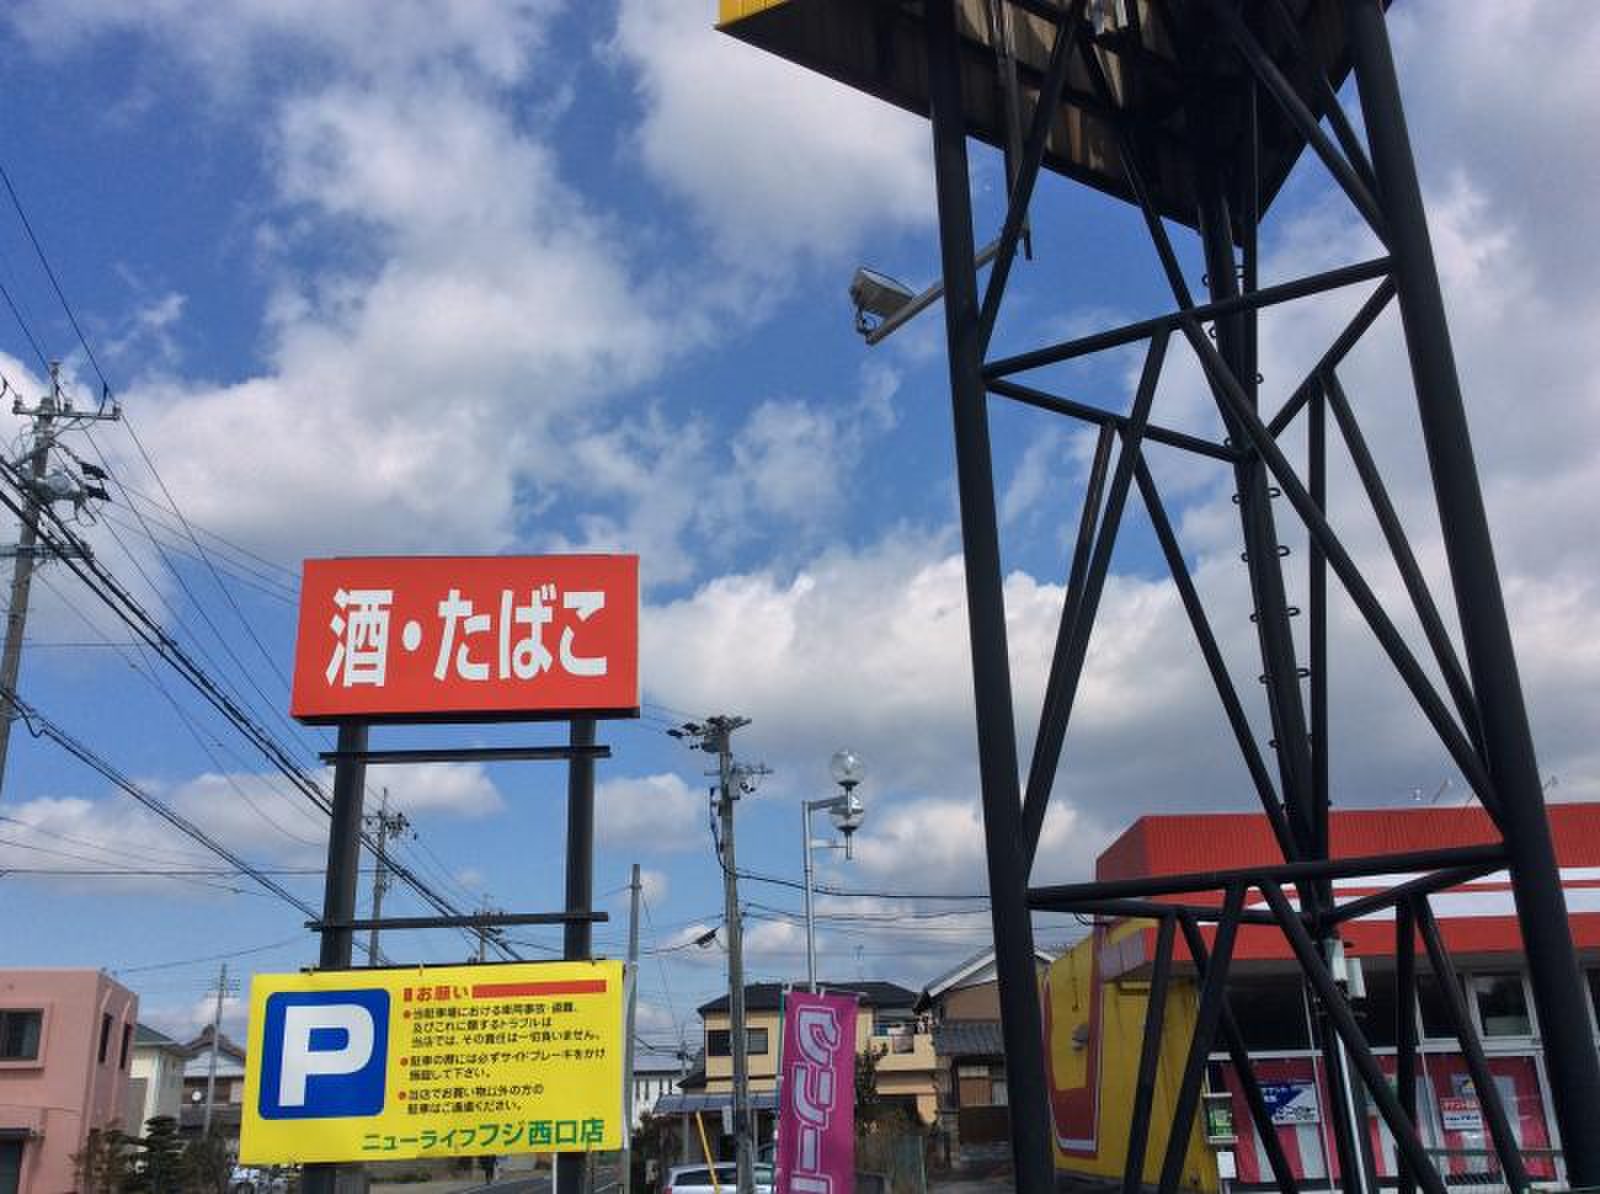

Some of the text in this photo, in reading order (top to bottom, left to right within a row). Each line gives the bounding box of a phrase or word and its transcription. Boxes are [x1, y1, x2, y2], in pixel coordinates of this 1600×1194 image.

[326, 584, 607, 687] 酒・たばこ
[278, 1003, 375, 1107] P
